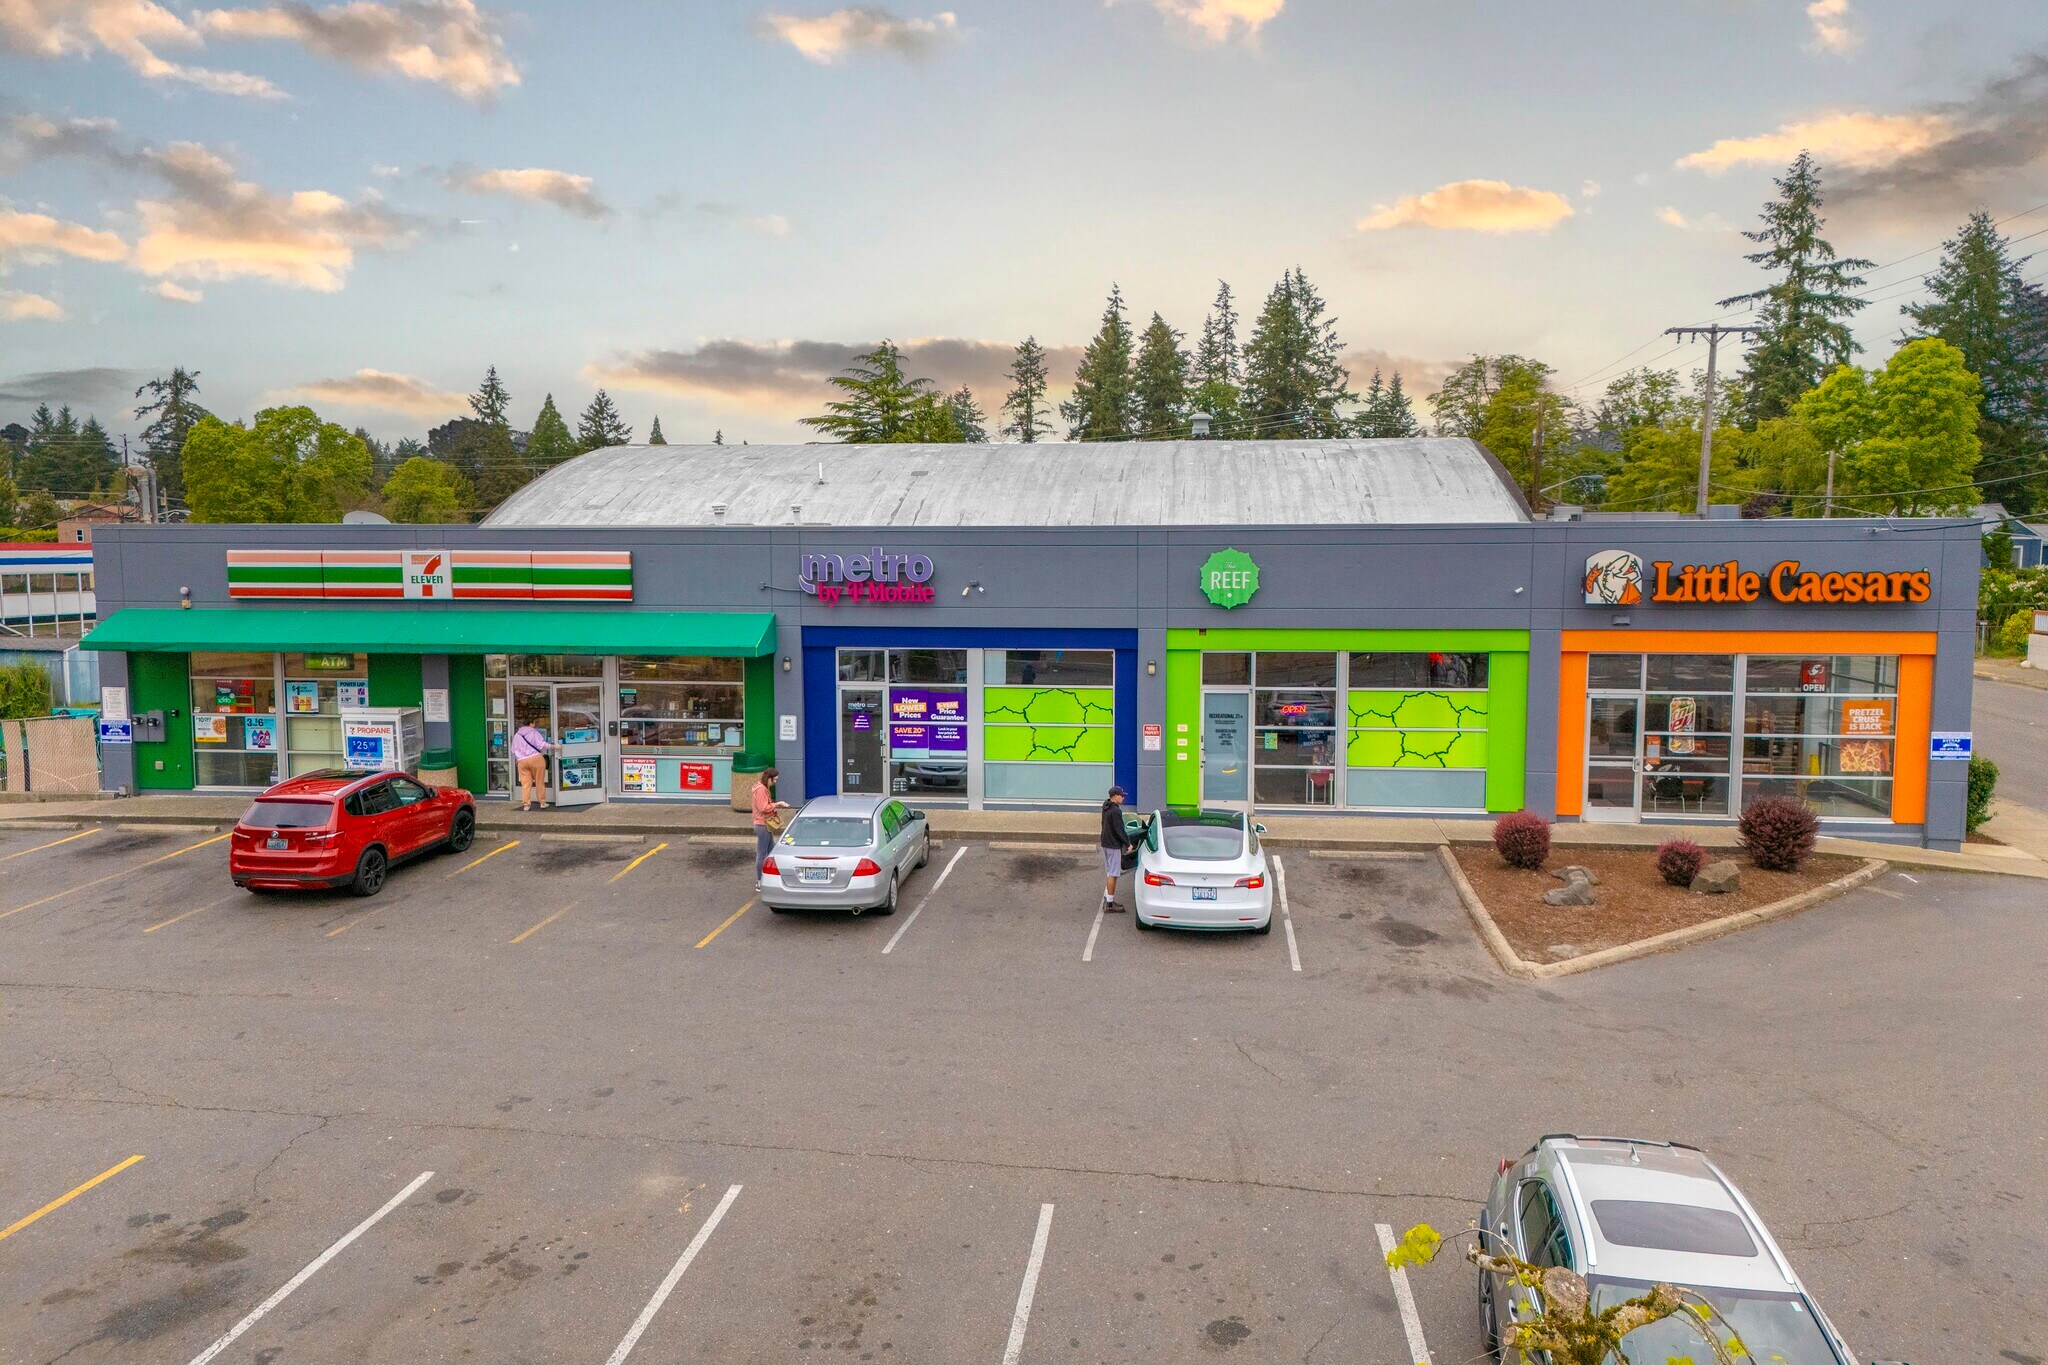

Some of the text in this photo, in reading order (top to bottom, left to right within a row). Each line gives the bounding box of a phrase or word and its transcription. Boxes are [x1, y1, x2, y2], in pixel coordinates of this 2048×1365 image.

[799, 547, 934, 593] metro
[1224, 561, 1236, 569] The
[411, 554, 441, 597] 7
[1211, 571, 1251, 590] REEF
[1651, 560, 1932, 603] Little Caesars
[818, 582, 843, 607] by
[321, 656, 347, 667] ATM
[1803, 683, 1825, 692] OPEN
[1282, 704, 1307, 714] OPEN
[1849, 708, 1885, 716] PRETZEL
[567, 731, 575, 740] $5
